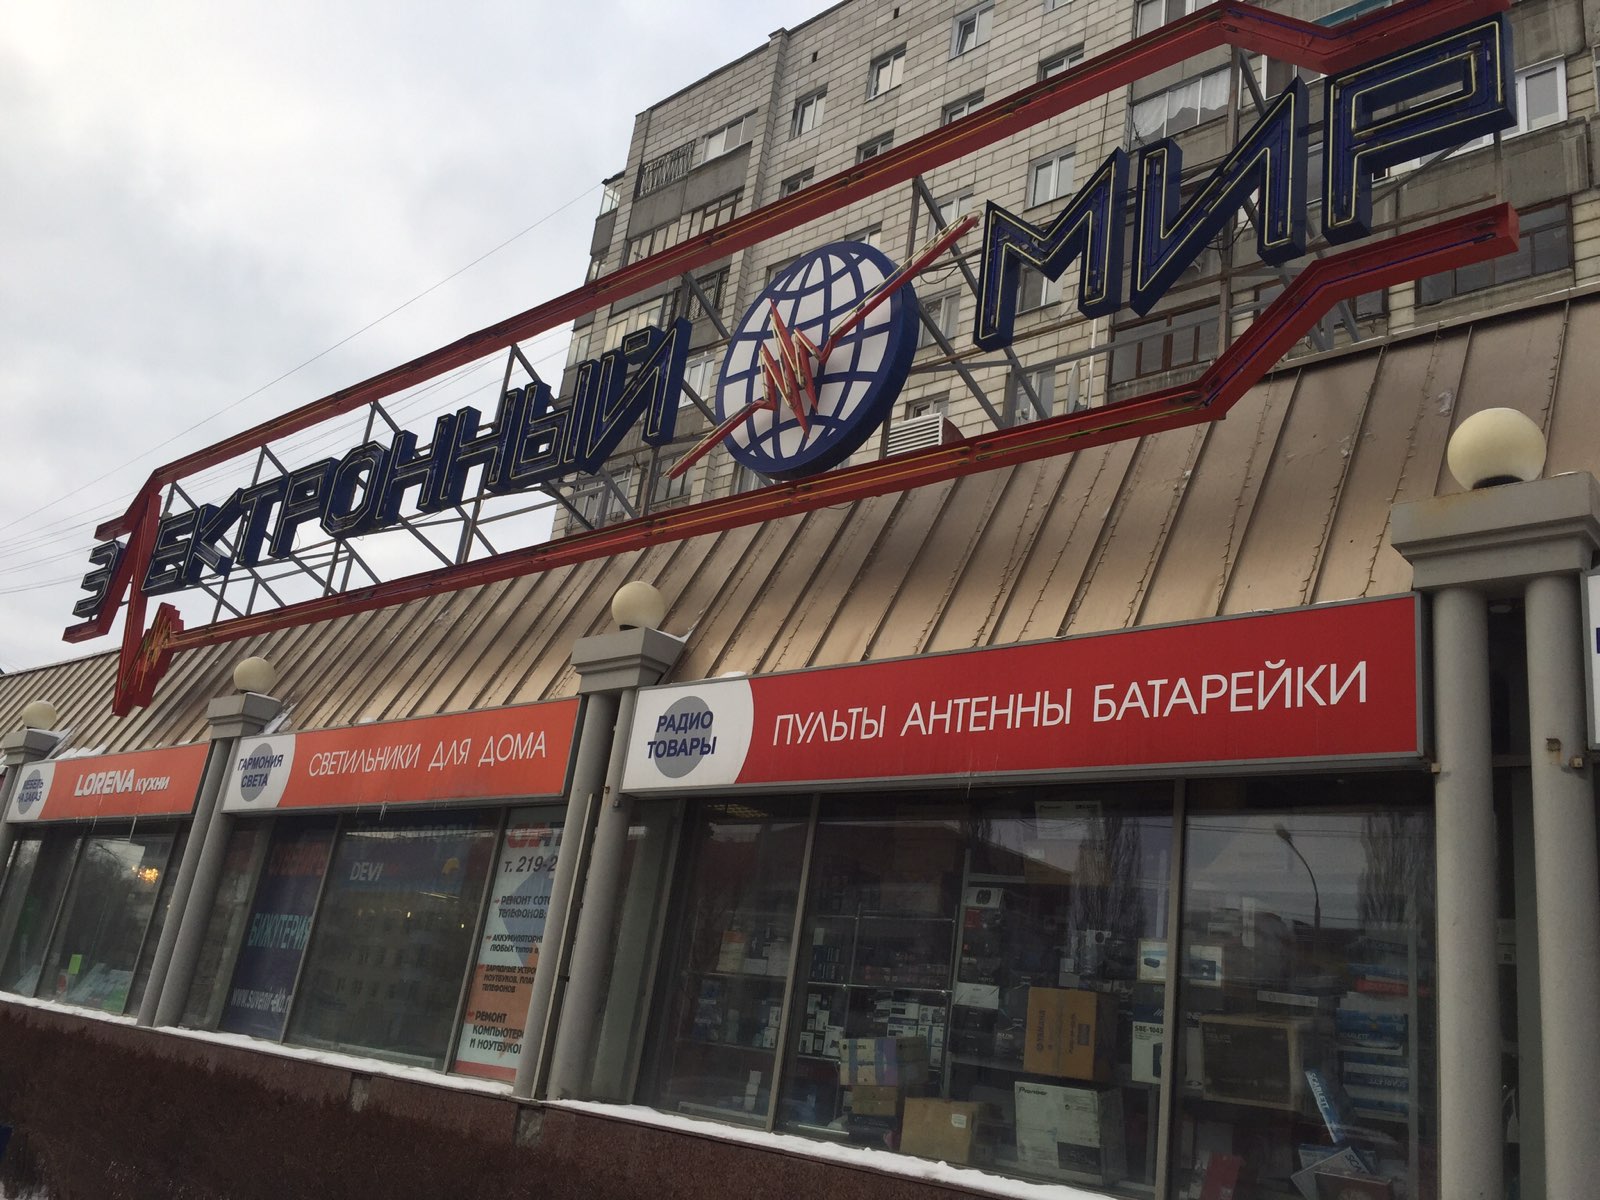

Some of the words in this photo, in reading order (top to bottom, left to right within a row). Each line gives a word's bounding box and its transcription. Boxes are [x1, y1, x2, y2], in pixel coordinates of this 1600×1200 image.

[973, 13, 1516, 353] МИР
[772, 705, 887, 747] ПУЛЬТЫ
[899, 687, 1073, 737] АНТЕННЫ
[1093, 658, 1368, 723] БАТАРЕЙКИ
[655, 710, 714, 735] РАДИО
[308, 743, 422, 777] СВЕТИЛЬНИКИ
[428, 738, 472, 772] ДЛЯ
[478, 730, 547, 768] ДОМА
[646, 736, 718, 760] ТОВАРЫ
[237, 754, 285, 772] ГАРМОНИЯ
[74, 768, 134, 797] LORENA
[240, 773, 269, 788] СВЕТА
[350, 861, 385, 882] DEVI
[501, 895, 531, 906] РЕМОНТ
[475, 1010, 508, 1024] РЕМОНТ
[469, 1038, 476, 1049] И
